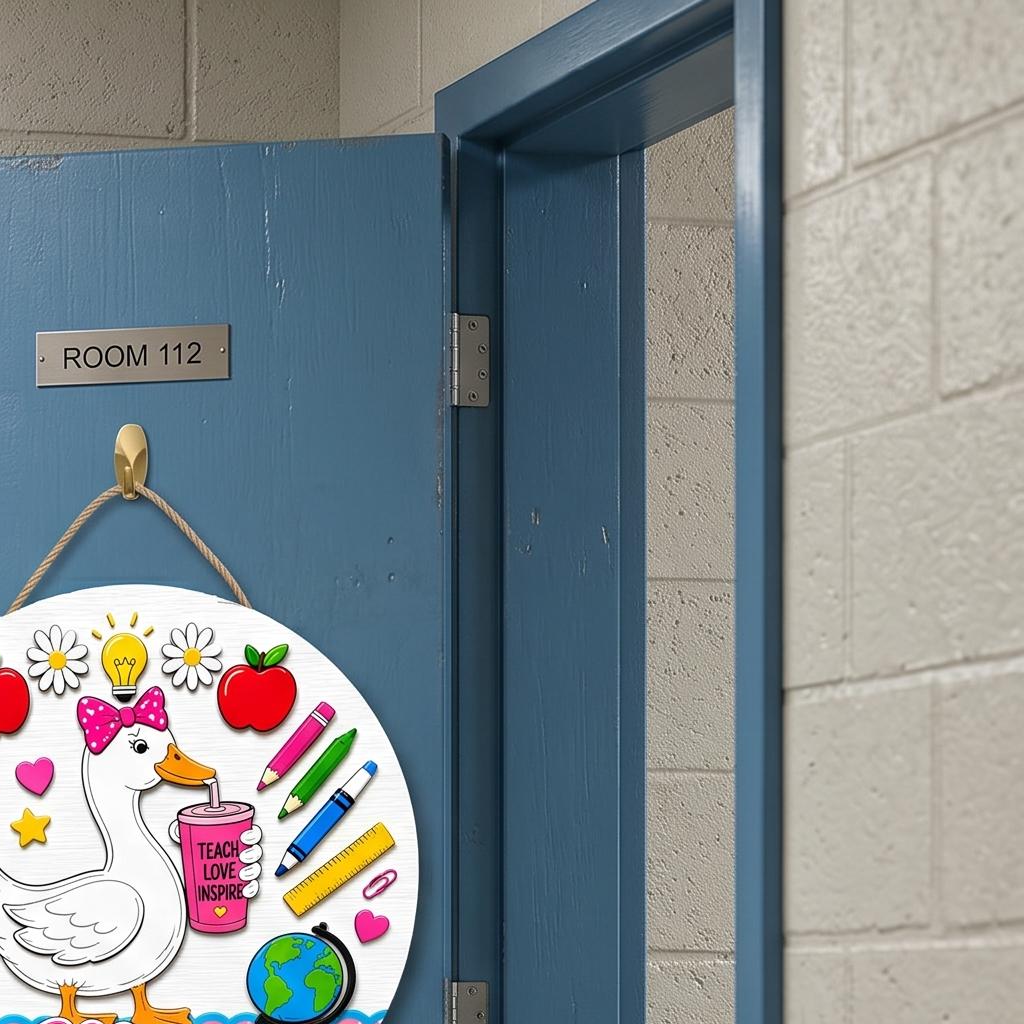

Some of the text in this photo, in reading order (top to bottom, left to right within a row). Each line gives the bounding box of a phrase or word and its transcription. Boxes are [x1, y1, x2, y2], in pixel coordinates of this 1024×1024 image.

[63, 342, 202, 369] ROOM 112
[197, 841, 240, 860] TEACH
[203, 862, 236, 881] LOVE
[197, 883, 244, 902] INSPIRE
